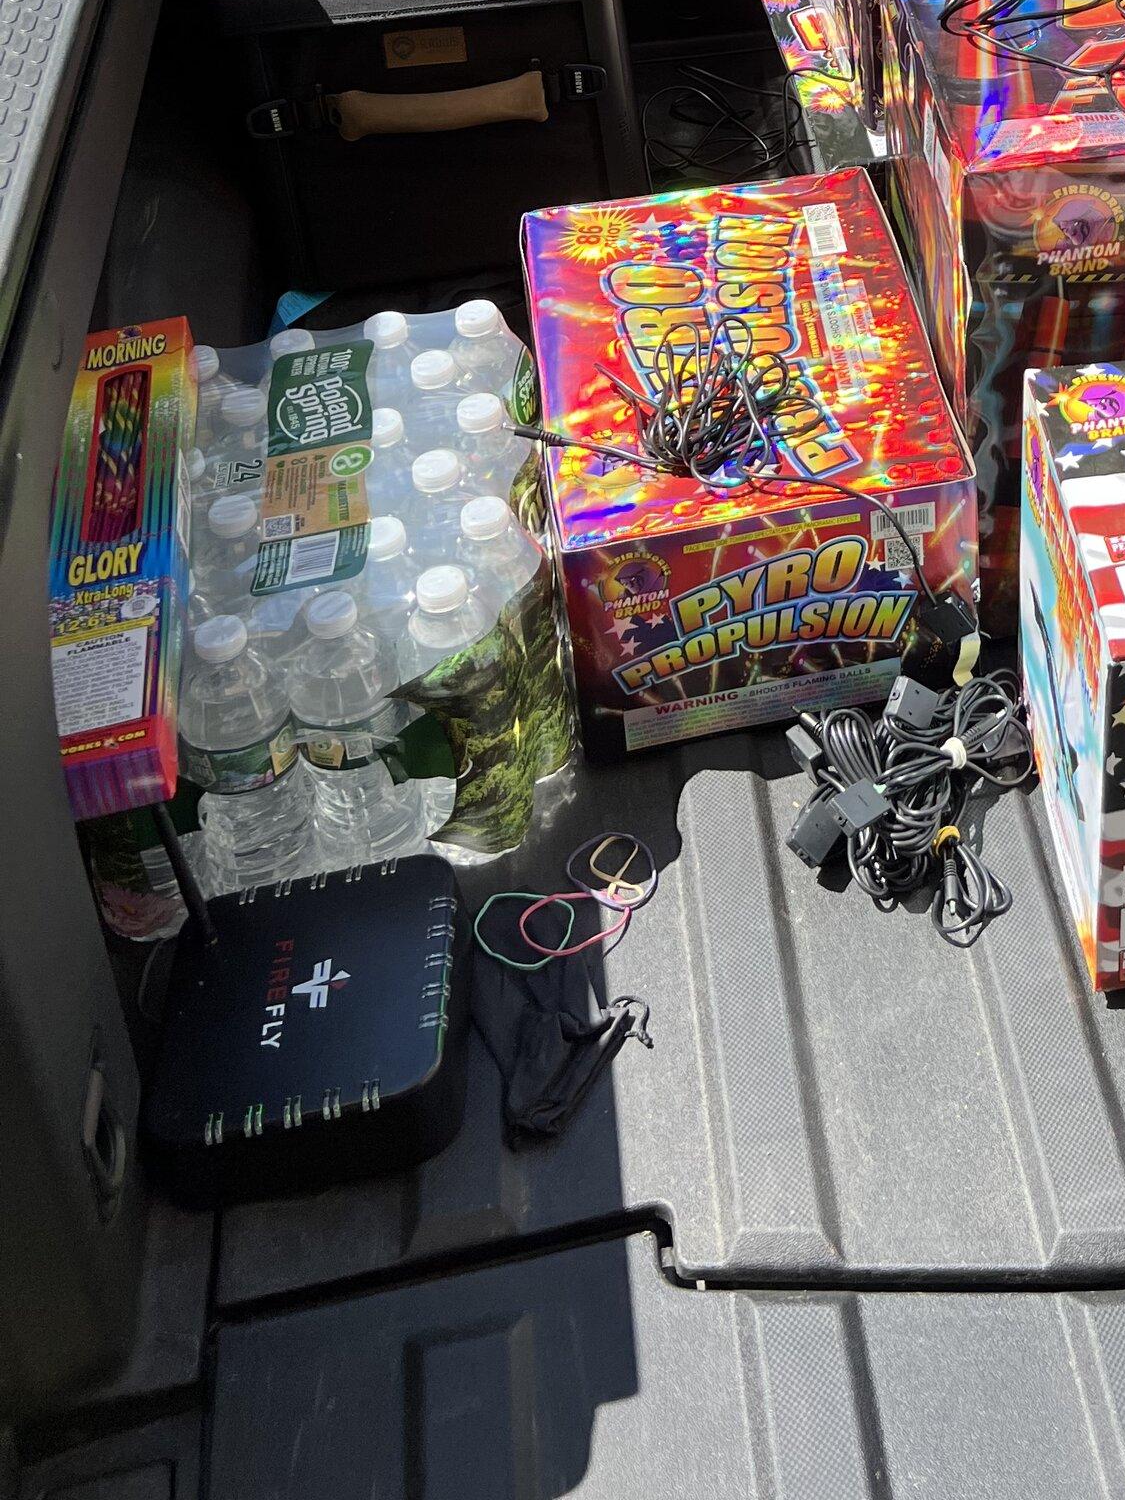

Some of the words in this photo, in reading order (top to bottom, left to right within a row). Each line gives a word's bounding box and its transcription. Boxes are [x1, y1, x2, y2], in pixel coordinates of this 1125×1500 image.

[1053, 184, 1125, 224] FIREWORKS
[575, 223, 604, 248] 86
[1037, 242, 1121, 264] PHANTOM
[1049, 257, 1110, 276] BRAND
[87, 334, 166, 369] MORNING
[806, 321, 822, 358] FIREWORKS
[290, 356, 305, 377] WATER
[315, 352, 330, 377] NATURAL
[285, 383, 331, 444] Spring
[315, 376, 362, 437] Poland
[288, 412, 300, 430] 1845
[233, 459, 263, 483] 24
[69, 542, 143, 587] GLORY
[608, 550, 671, 577] FIREWORKS
[676, 538, 866, 636] PYRO
[604, 588, 670, 612] PHANTOM
[614, 601, 662, 619] BRAND
[67, 638, 131, 656] FLAMMABLE
[76, 633, 124, 648] CAUTION
[618, 594, 912, 692] PROPULSION
[654, 691, 739, 716] WARNING
[749, 681, 790, 697] SHOOTS
[792, 673, 837, 689] FLAMING
[839, 667, 872, 681] BALLS
[117, 729, 146, 743] COM
[259, 939, 295, 1050] FIREFLY
